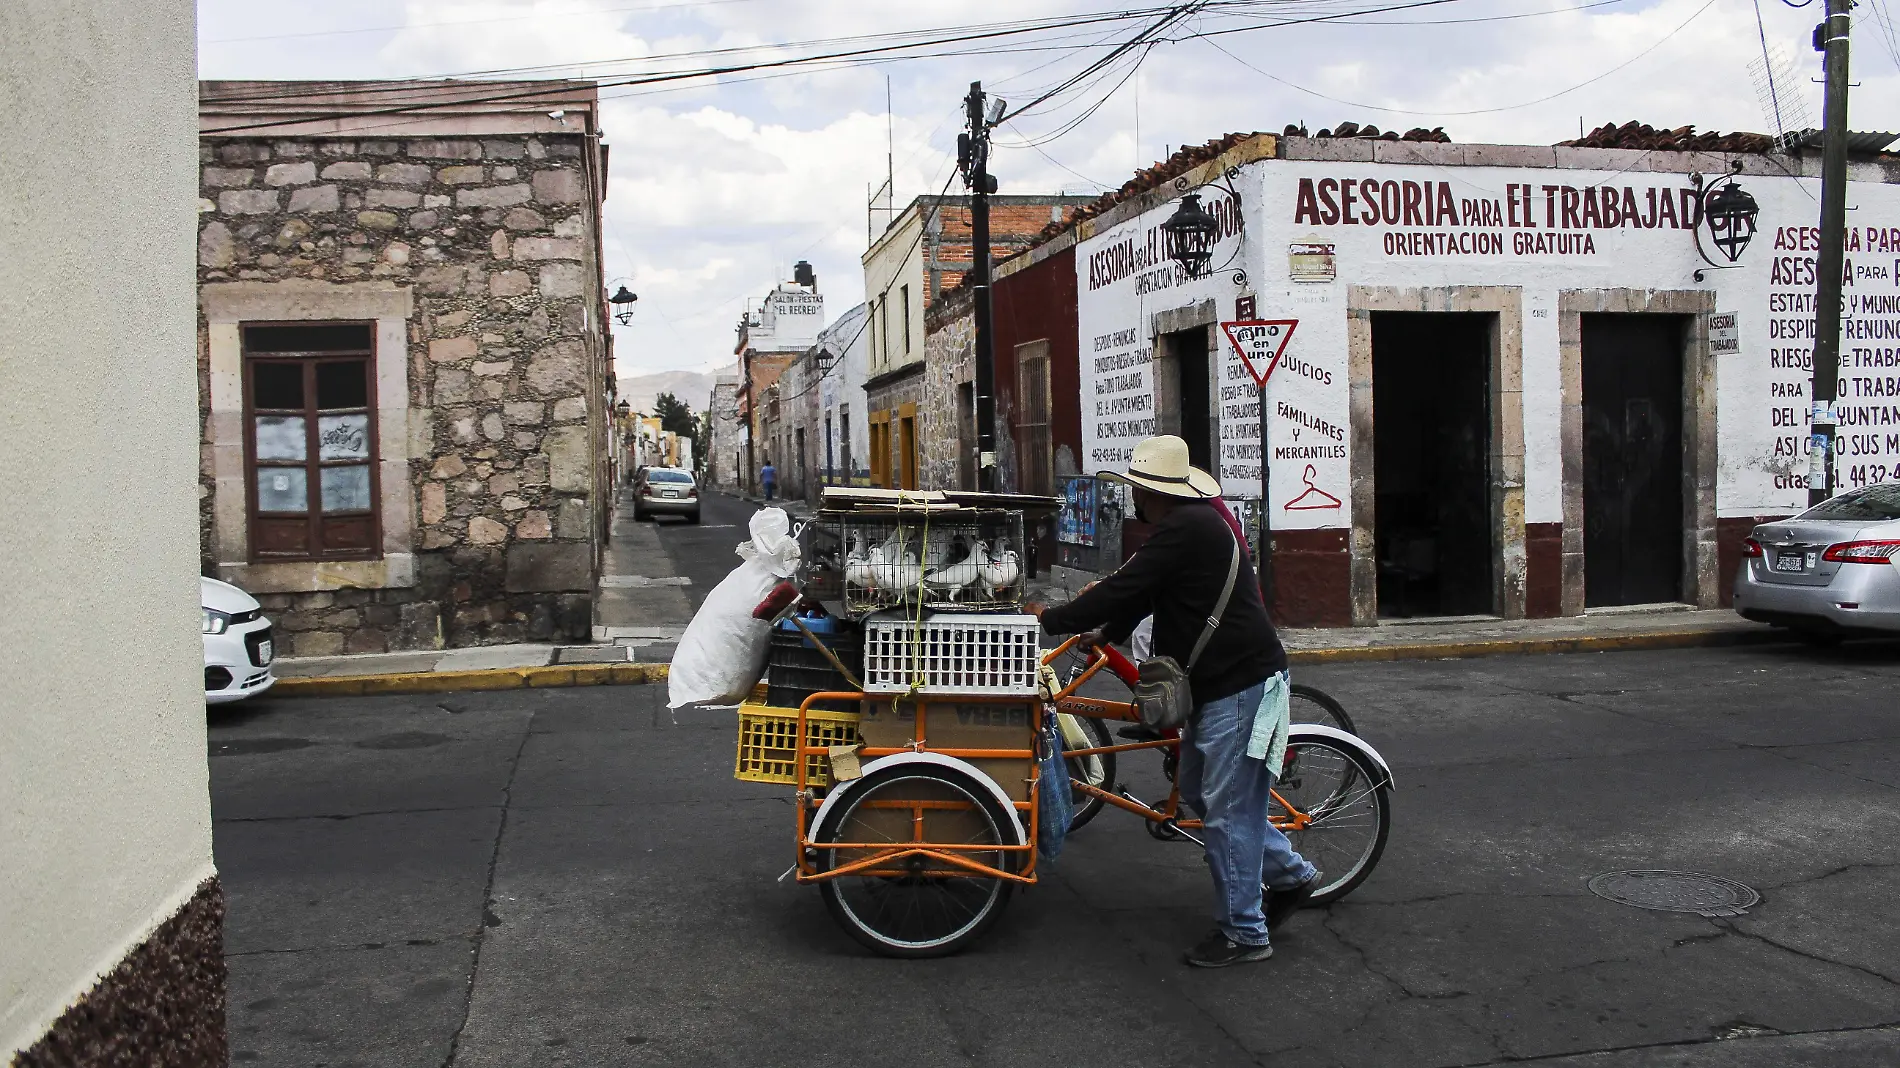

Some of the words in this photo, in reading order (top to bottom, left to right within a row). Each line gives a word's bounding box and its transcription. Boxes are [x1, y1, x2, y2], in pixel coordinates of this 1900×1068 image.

[1294, 178, 1460, 226] ASESORIA
[1461, 198, 1504, 227] PARA
[1506, 183, 1537, 228] EL
[1384, 232, 1503, 256] ORIENTACION
[1513, 231, 1596, 256] GRATUITA
[1089, 238, 1135, 291] ASESORIA
[1147, 226, 1158, 266] EL
[1135, 266, 1172, 296] ORIENTACION
[1857, 266, 1888, 279] PARA
[1850, 294, 1858, 314] Y
[1710, 315, 1735, 330] ASESORIA
[1253, 340, 1269, 348] en
[1710, 338, 1737, 351] TRABAJADOR
[1247, 350, 1275, 359] uno
[1280, 354, 1332, 385] JUICIOS
[1771, 382, 1803, 397] PARA
[1111, 393, 1152, 415] AYUNTAMIENTO
[1277, 401, 1345, 442] FAMILIARES
[1772, 407, 1798, 427] DEL
[1292, 428, 1301, 442] Y
[1774, 436, 1798, 456] ASI
[1852, 434, 1879, 455] SUS
[1275, 445, 1346, 460] MERCANTILES
